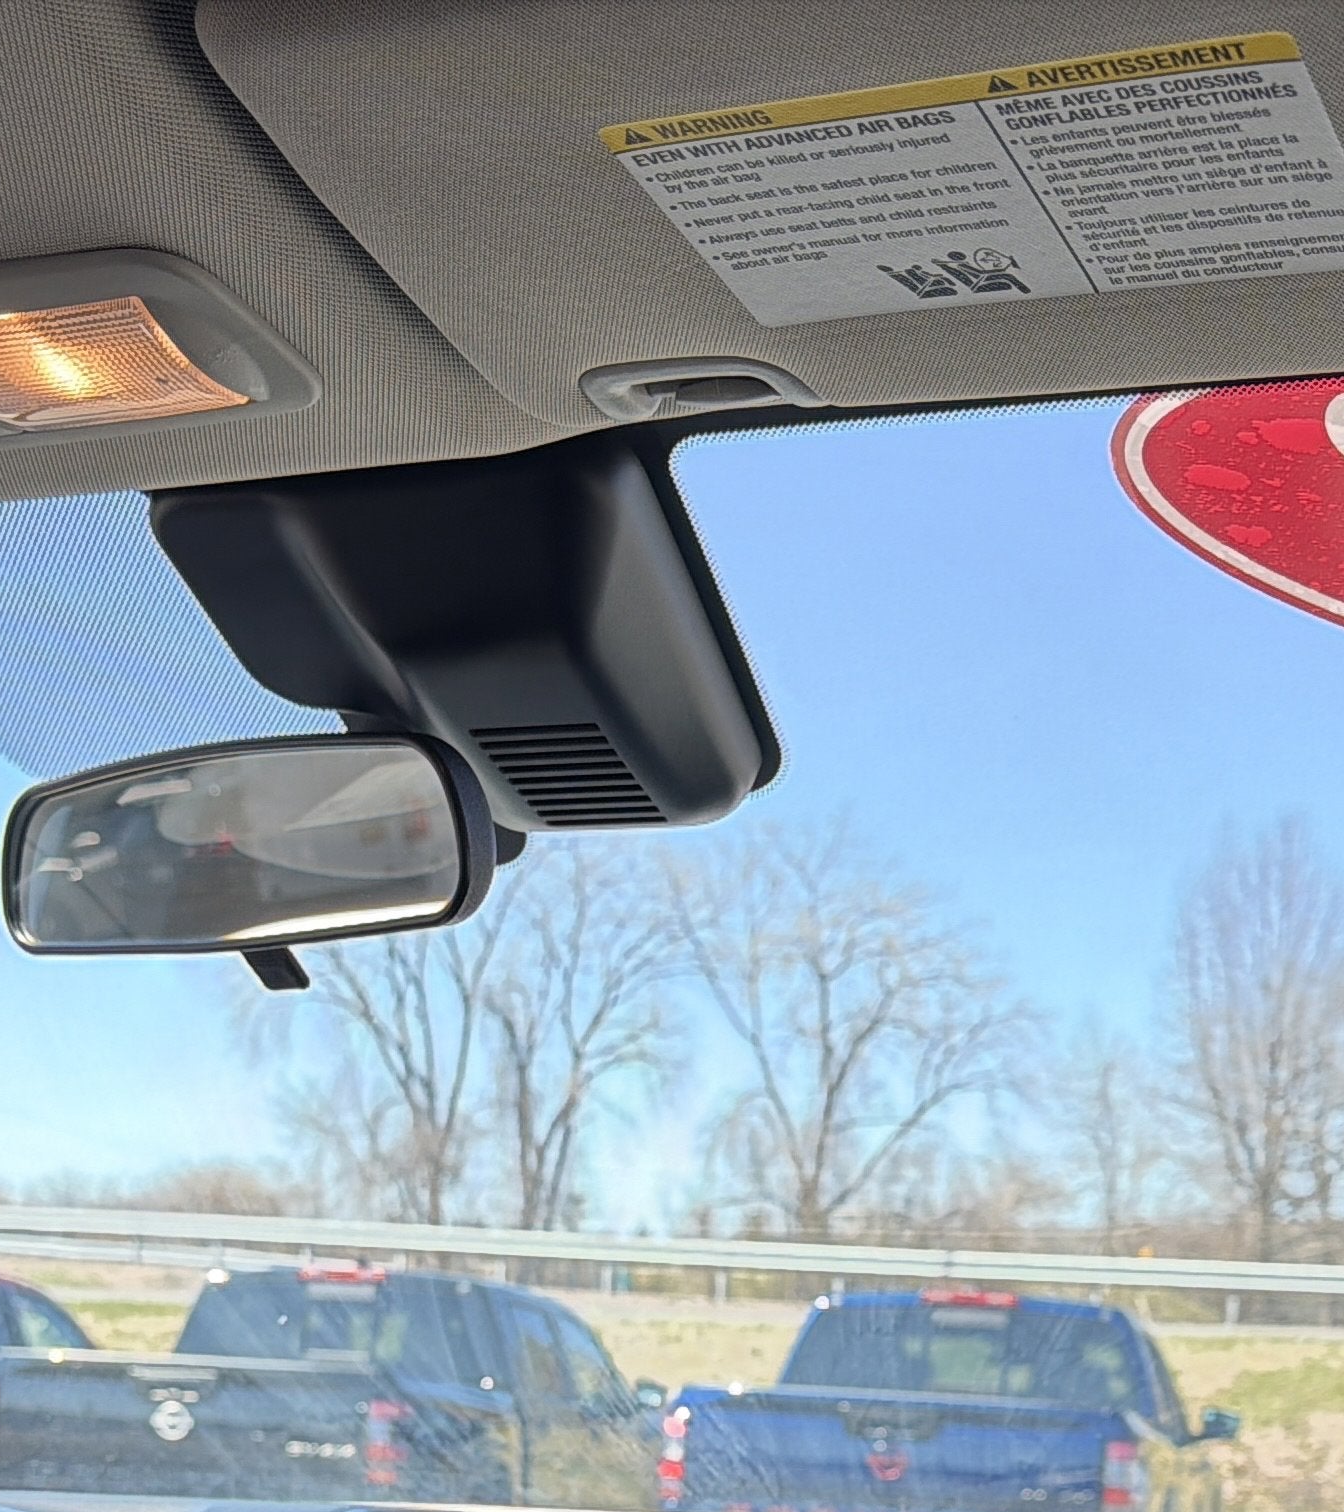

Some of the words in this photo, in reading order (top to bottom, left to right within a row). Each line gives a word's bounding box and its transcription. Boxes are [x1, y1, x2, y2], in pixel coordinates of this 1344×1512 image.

[1028, 43, 1244, 86] AVERTISSEMENT
[995, 97, 1057, 116] MÊME
[1061, 90, 1112, 108] AVEC
[1115, 84, 1157, 100] DES
[1160, 71, 1263, 94] COUSSINS
[1005, 105, 1131, 130] GONFLABLES
[1134, 84, 1297, 113] PERFECTIONNÉS
[631, 148, 686, 167] EVEN
[685, 140, 743, 158] WITH
[744, 125, 853, 150] ADVANCED
[857, 119, 895, 135] AIR
[894, 110, 956, 130] BAGS
[652, 110, 772, 139] WARNING
[1019, 135, 1050, 146] Les
[1051, 127, 1109, 142] enfants
[1111, 118, 1174, 137] peuvent
[1176, 115, 1208, 127] être
[1210, 107, 1271, 123] blessés
[1029, 138, 1114, 159] grièvement
[1116, 136, 1137, 147] ou
[1139, 123, 1241, 144] mortellement
[655, 166, 715, 183] Children
[716, 162, 745, 174] can
[743, 159, 766, 169] be
[765, 152, 808, 166] killed
[809, 151, 825, 161] or
[828, 142, 895, 158] seriously
[896, 133, 951, 149] injured
[1036, 161, 1058, 172] La
[1058, 152, 1135, 169] banquette
[1137, 146, 1189, 160] arrière
[1191, 141, 1217, 153] est
[1217, 140, 1235, 150] la
[1237, 136, 1280, 150] place
[1281, 133, 1299, 143] la
[1045, 172, 1078, 184] plus
[1079, 162, 1159, 179] sécuritaire
[1161, 157, 1195, 171] pour
[1198, 154, 1224, 165] les
[1226, 148, 1284, 162] enfants
[663, 183, 683, 194] by
[683, 179, 710, 190] the
[710, 175, 730, 186] air
[730, 172, 762, 183] bag
[678, 199, 707, 210] The
[707, 193, 744, 206] back
[744, 188, 778, 201] seat
[776, 186, 793, 197] is
[793, 184, 820, 195] the
[820, 177, 867, 191] safest
[868, 172, 909, 187] place
[909, 169, 932, 179] for
[935, 161, 997, 176] children
[1052, 186, 1075, 197] Ne
[1076, 180, 1127, 196] jamais
[1129, 174, 1179, 187] mettre
[1181, 172, 1203, 182] un
[1204, 167, 1247, 179] siège
[1249, 159, 1313, 175] d'enfant
[1061, 191, 1139, 207] orientation
[1141, 188, 1175, 198] vers
[1176, 180, 1237, 194] l'arrière
[1239, 178, 1264, 188] sur
[1267, 176, 1289, 185] un
[1291, 172, 1333, 183] siège
[692, 214, 735, 227] Never
[737, 210, 763, 223] put
[763, 209, 776, 218] a
[775, 199, 855, 216] rear-facing
[855, 193, 892, 206] child
[893, 189, 927, 201] seat
[926, 187, 944, 197] in
[944, 184, 972, 195] the
[972, 178, 1010, 191] front
[1068, 205, 1109, 218] avant
[1076, 217, 1138, 231] Toujours
[1139, 211, 1189, 224] utiliser
[1191, 208, 1216, 219] les
[1218, 201, 1289, 216] ceintures
[1291, 198, 1311, 208] de
[708, 230, 759, 245] Always
[759, 227, 787, 237] use
[787, 221, 820, 233] seat
[819, 217, 858, 229] belts
[858, 212, 887, 225] and
[888, 208, 925, 221] child
[926, 200, 997, 216] restraints
[721, 250, 750, 261] See
[751, 242, 807, 257] owner's
[807, 234, 861, 249] manual
[861, 233, 882, 243] for
[885, 228, 924, 240] more
[924, 219, 1009, 235] information
[1082, 227, 1141, 242] sécurité
[1143, 225, 1160, 235] et
[1159, 223, 1184, 233] les
[1186, 215, 1262, 231] dispositifs
[1264, 212, 1285, 223] de
[730, 257, 771, 270] about
[771, 254, 790, 265] air
[792, 250, 828, 262] bags
[1088, 237, 1149, 252] d'enfant
[1095, 254, 1129, 265] Pour
[1132, 251, 1152, 261] de
[1154, 248, 1186, 261] plus
[1188, 242, 1242, 255] amples
[1102, 266, 1126, 275] sur
[1127, 263, 1152, 273] les
[1153, 256, 1217, 270] coussins
[1108, 276, 1124, 286] le
[1125, 270, 1179, 284] manuel
[1180, 268, 1201, 279] du
[1203, 261, 1283, 277] conducteur
